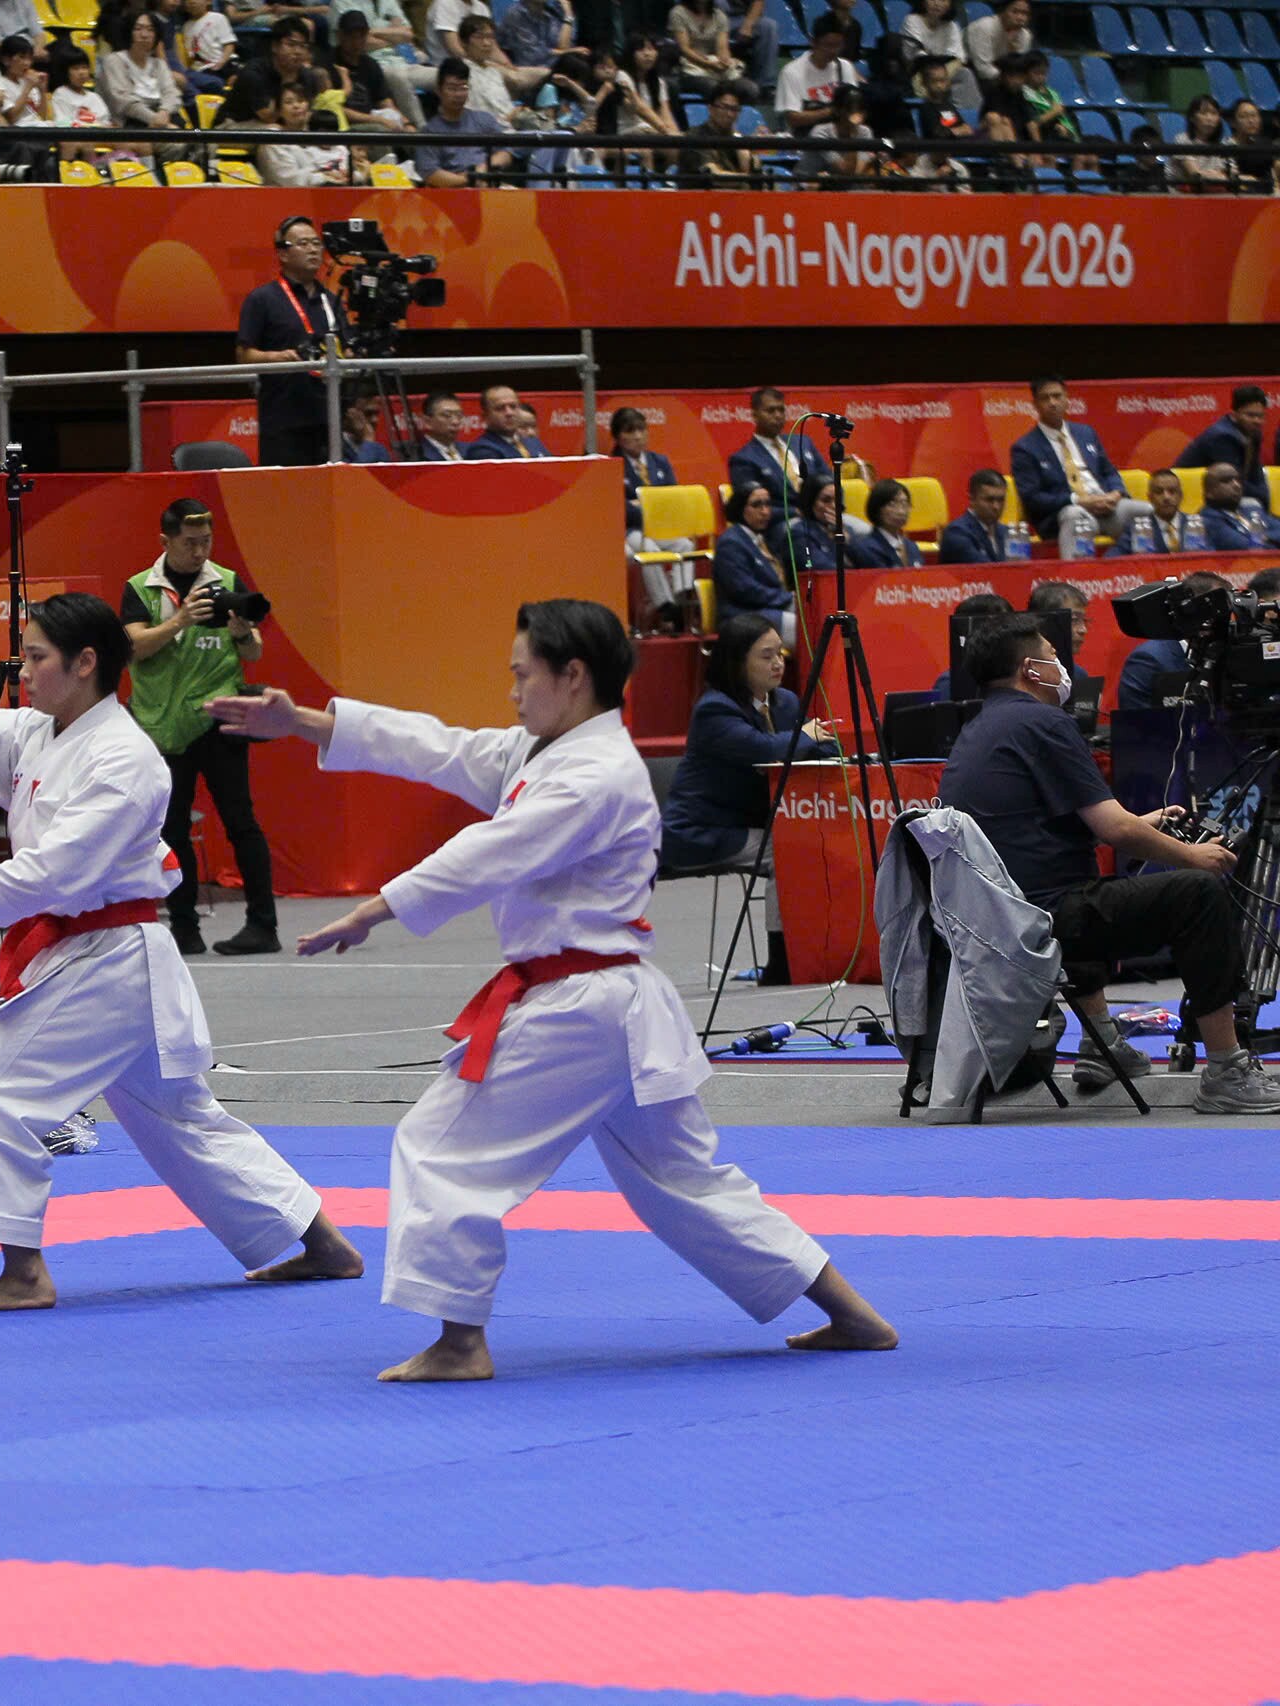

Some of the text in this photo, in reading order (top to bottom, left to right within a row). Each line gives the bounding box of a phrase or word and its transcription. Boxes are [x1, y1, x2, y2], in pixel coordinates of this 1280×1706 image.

[675, 212, 1135, 309] Aichi-Nagoya 2026
[875, 583, 960, 608] Aichi-Nagoya
[195, 635, 222, 650] 471
